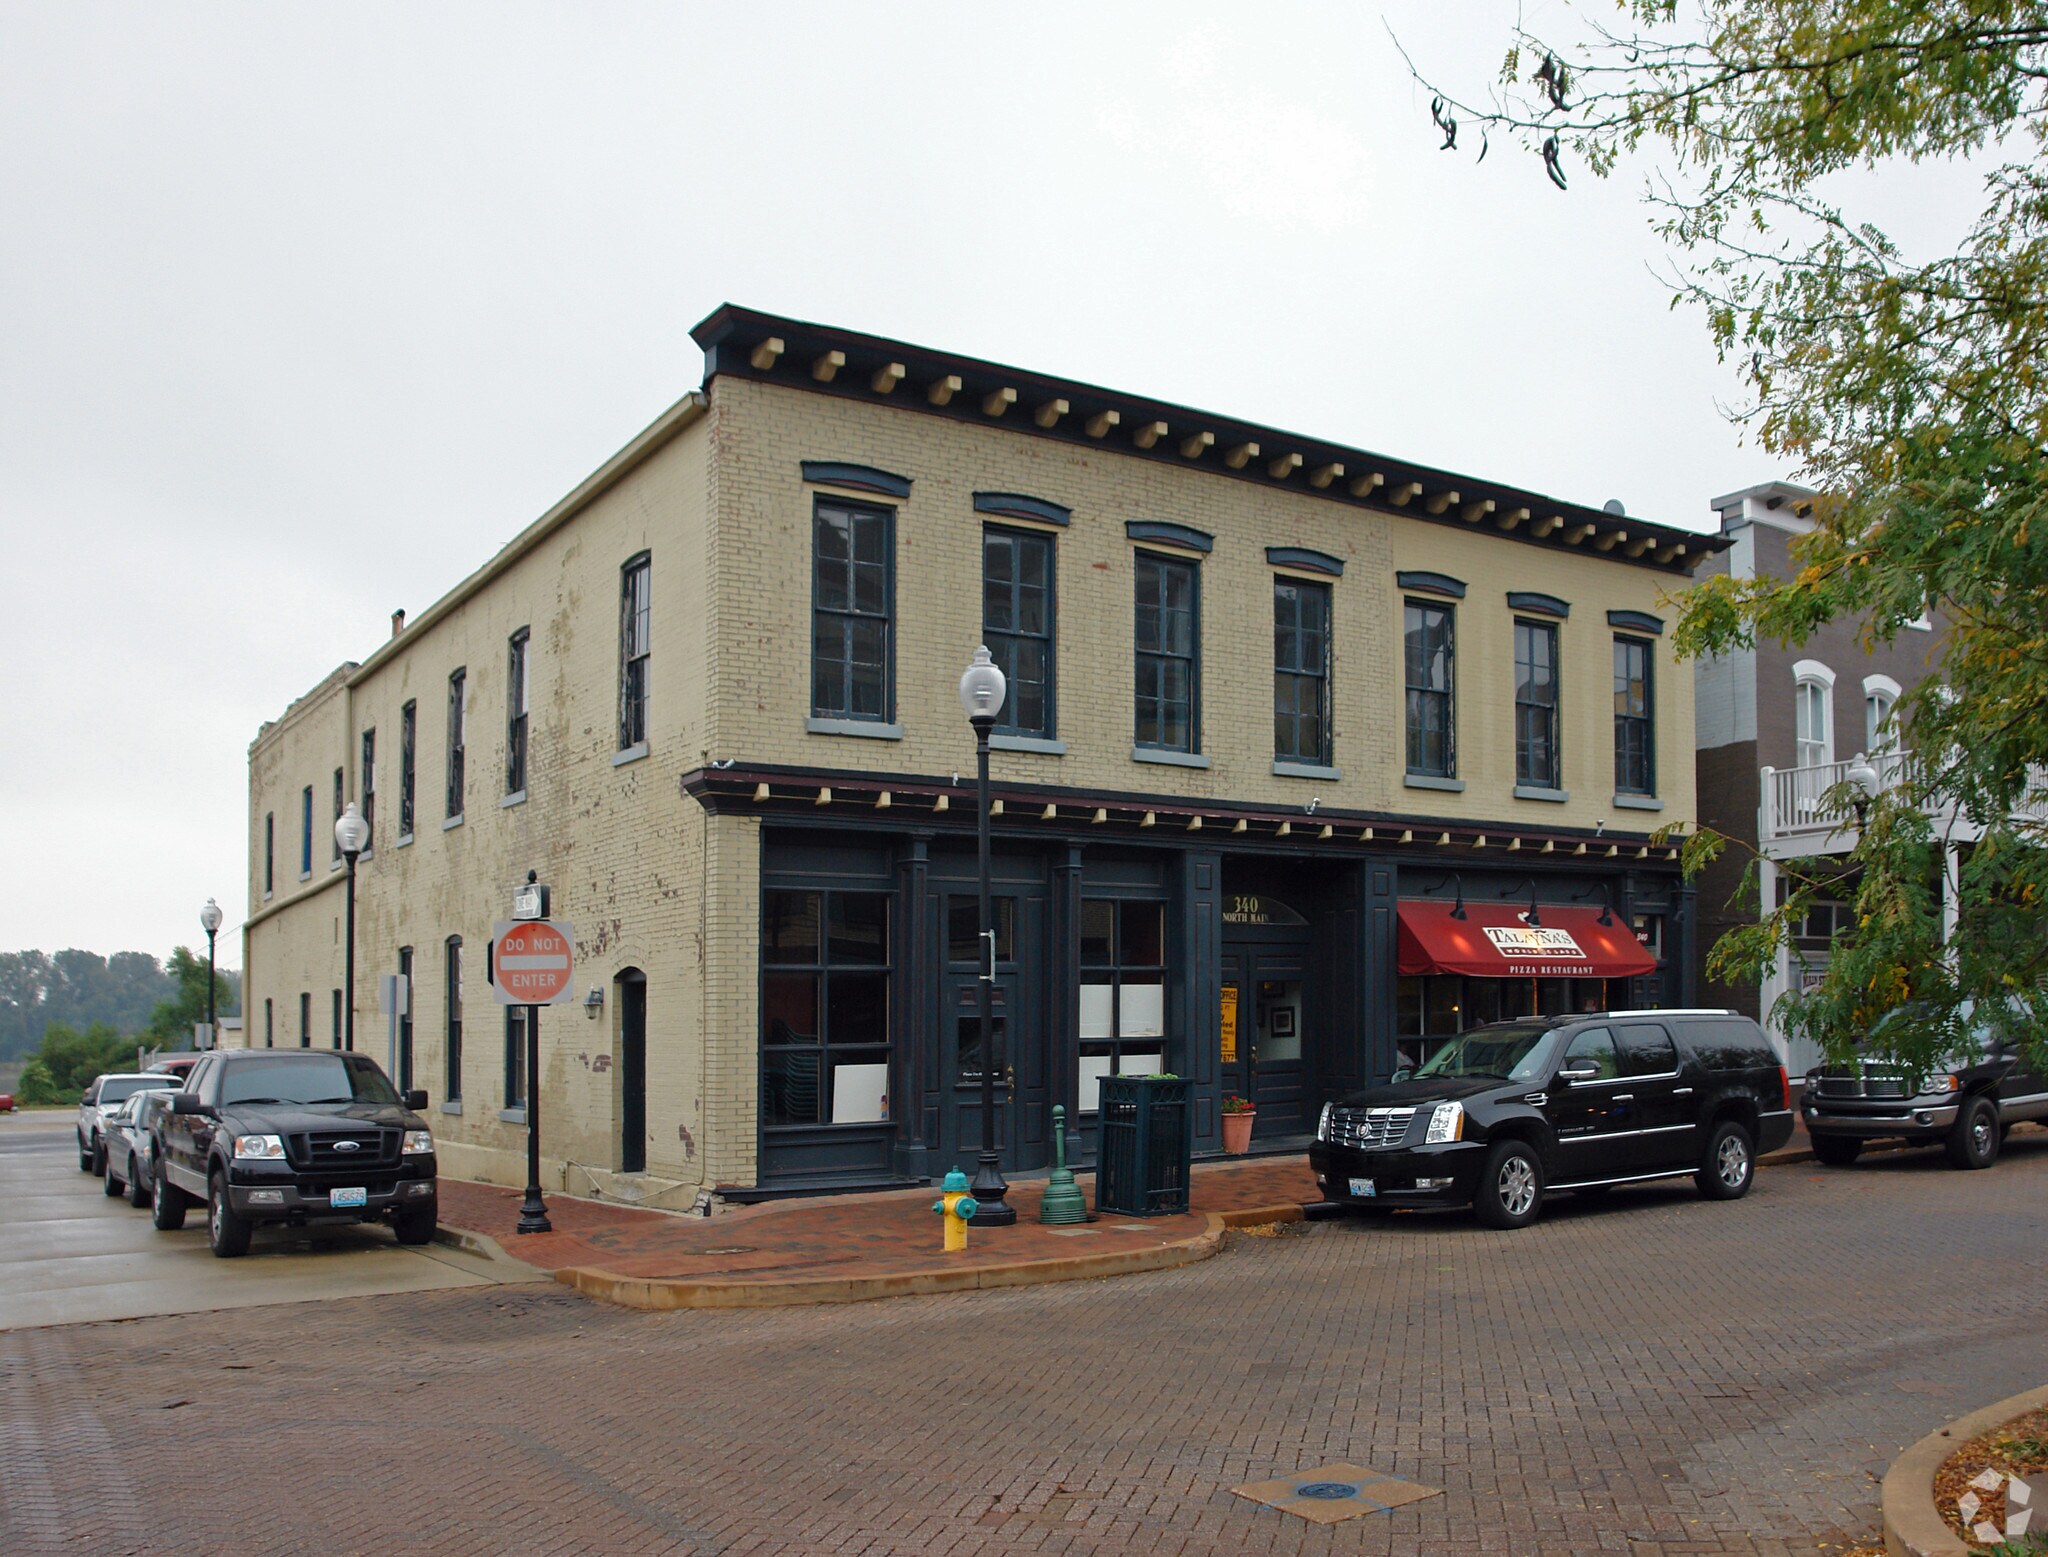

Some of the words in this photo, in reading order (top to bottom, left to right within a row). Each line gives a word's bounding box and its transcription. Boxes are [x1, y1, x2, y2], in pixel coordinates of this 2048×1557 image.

[1234, 896, 1259, 913] 340
[1222, 912, 1248, 922] NORTH
[1250, 913, 1269, 923] MAIN
[1487, 929, 1572, 946] TALAYNA'S
[505, 938, 525, 951] DO
[533, 938, 561, 951] NOT
[1509, 965, 1537, 974] PIZZA
[1540, 965, 1594, 975] RESTAURANT
[512, 973, 556, 987] ENTER
